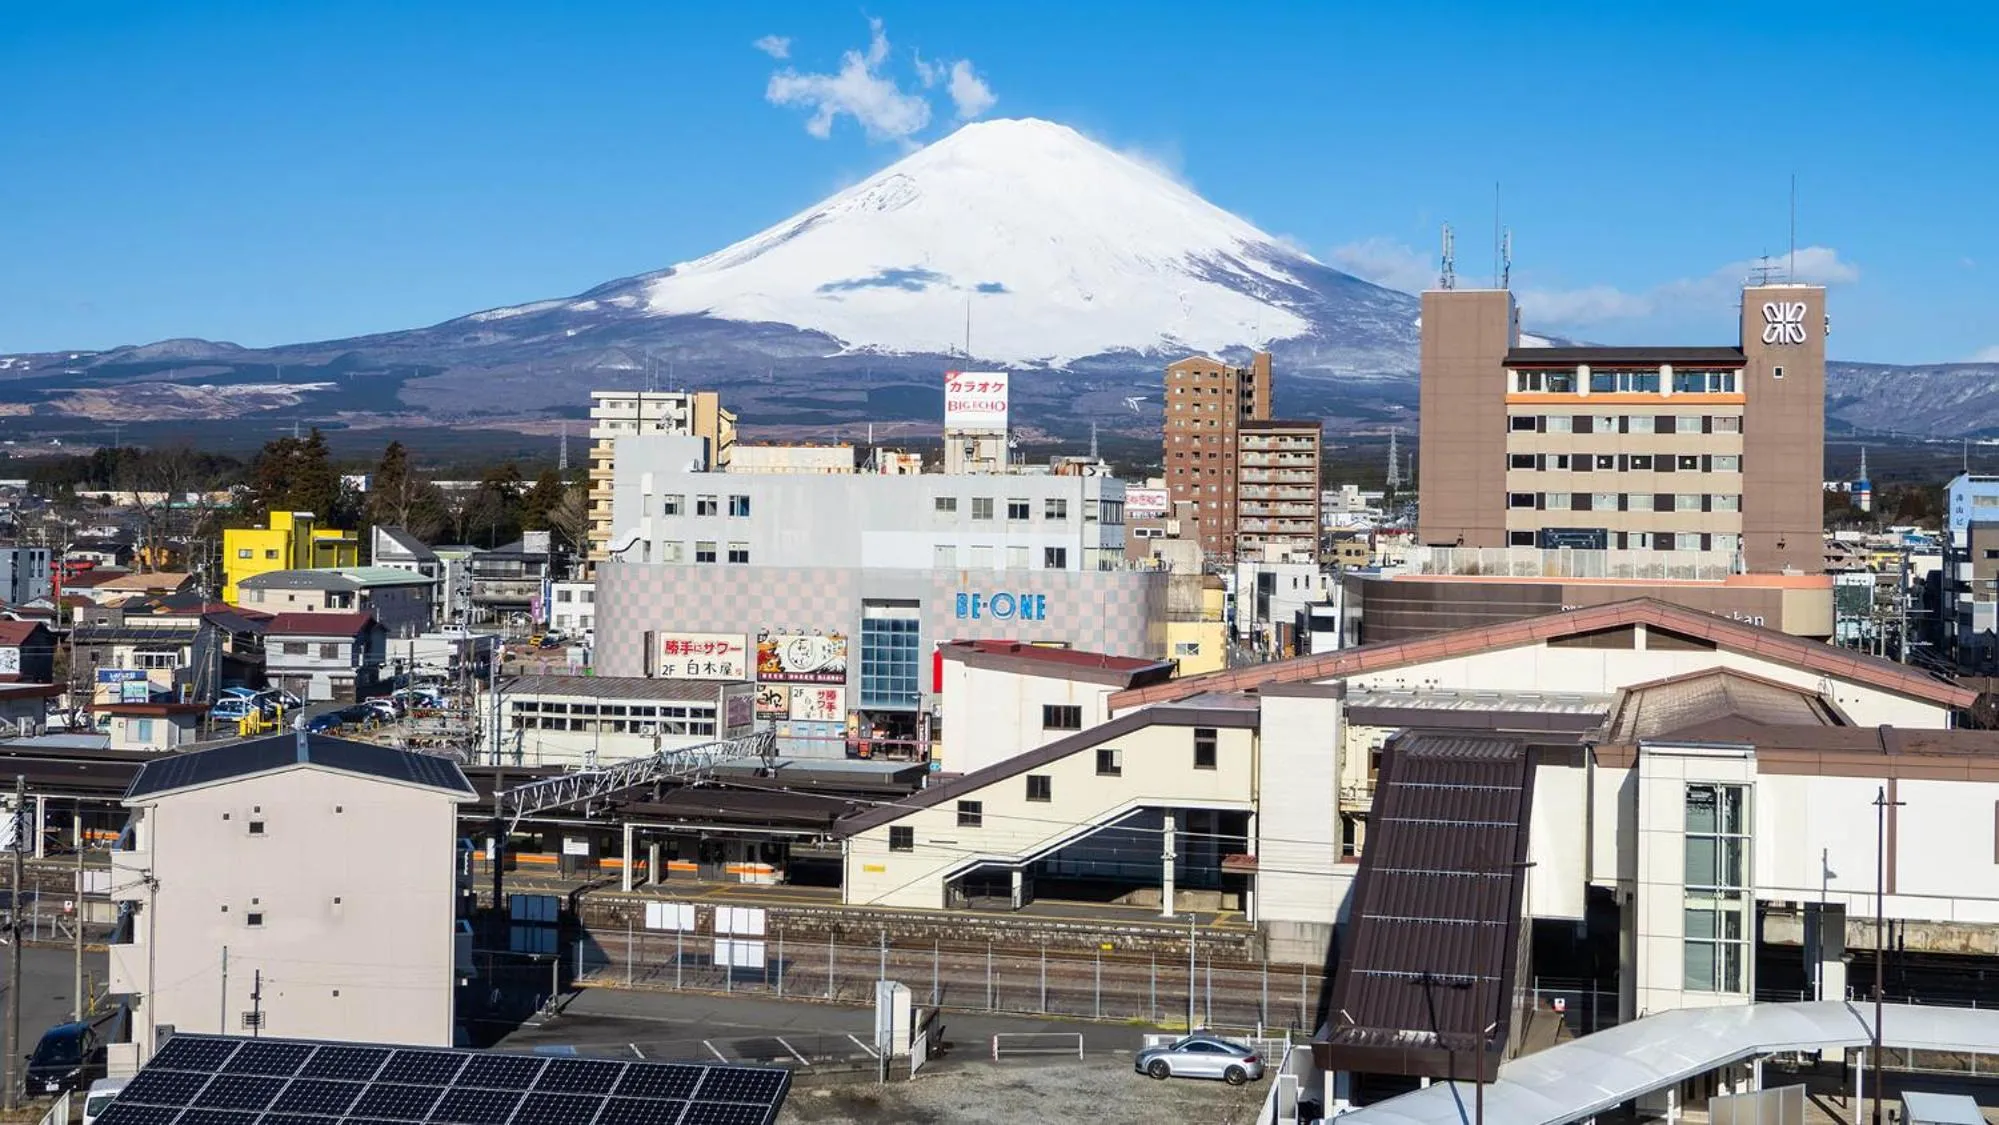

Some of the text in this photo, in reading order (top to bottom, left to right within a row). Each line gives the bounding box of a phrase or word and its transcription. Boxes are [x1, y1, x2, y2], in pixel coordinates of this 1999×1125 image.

[949, 381, 1005, 392] カラオケ
[948, 400, 1006, 411] BIG ECHO
[665, 640, 742, 656] 勝手にサワー
[662, 664, 676, 676] 2F
[687, 659, 732, 676] 白木屋
[794, 688, 805, 698] 2F
